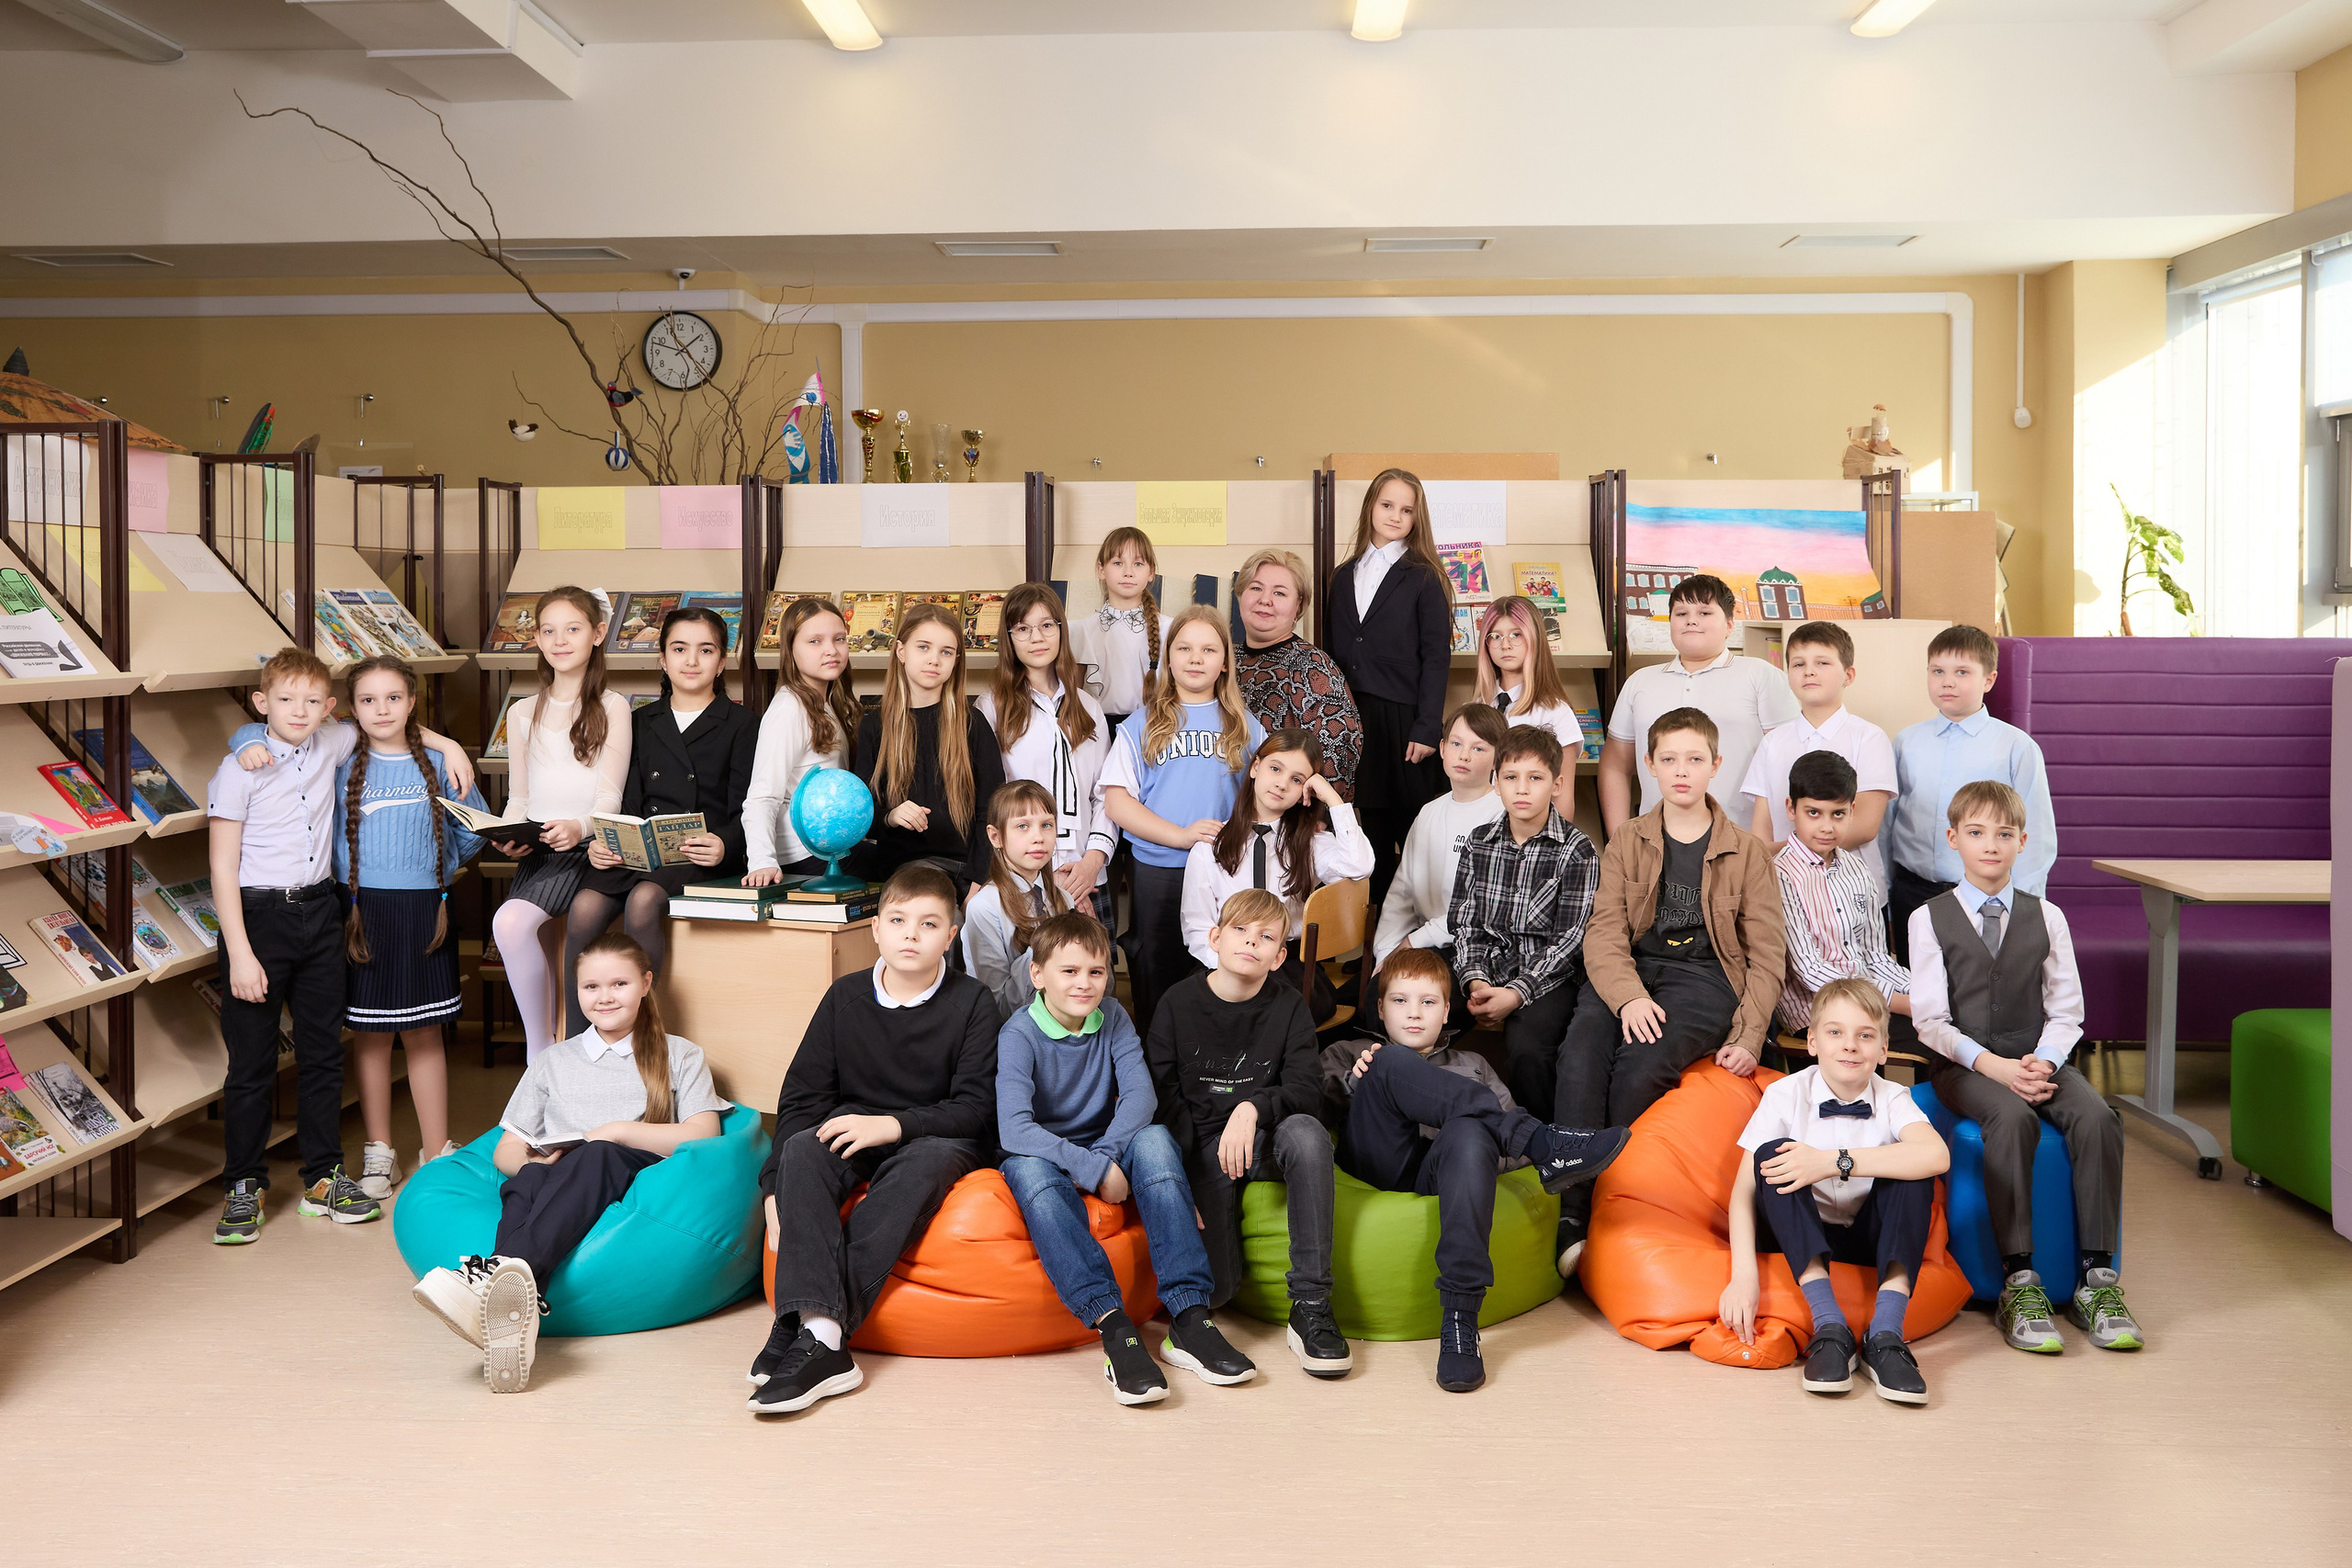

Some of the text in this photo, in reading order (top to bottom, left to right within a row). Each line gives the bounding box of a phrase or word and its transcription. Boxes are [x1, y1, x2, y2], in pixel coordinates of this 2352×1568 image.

[676, 323, 684, 332] 12
[704, 345, 708, 354] 3
[14, 457, 83, 503] Атрномия
[554, 507, 612, 534] Литература
[677, 506, 733, 532] Искусство
[879, 505, 935, 533] История
[1139, 502, 1223, 527] Большая Энциклопедия
[1429, 502, 1504, 528] атематика
[1435, 542, 1481, 550] КОЛЬНИКА
[345, 781, 429, 800] harming
[658, 822, 701, 832] ГАЙДАР
[605, 829, 619, 856] АЙДАР
[1566, 1157, 1583, 1168] adidas
